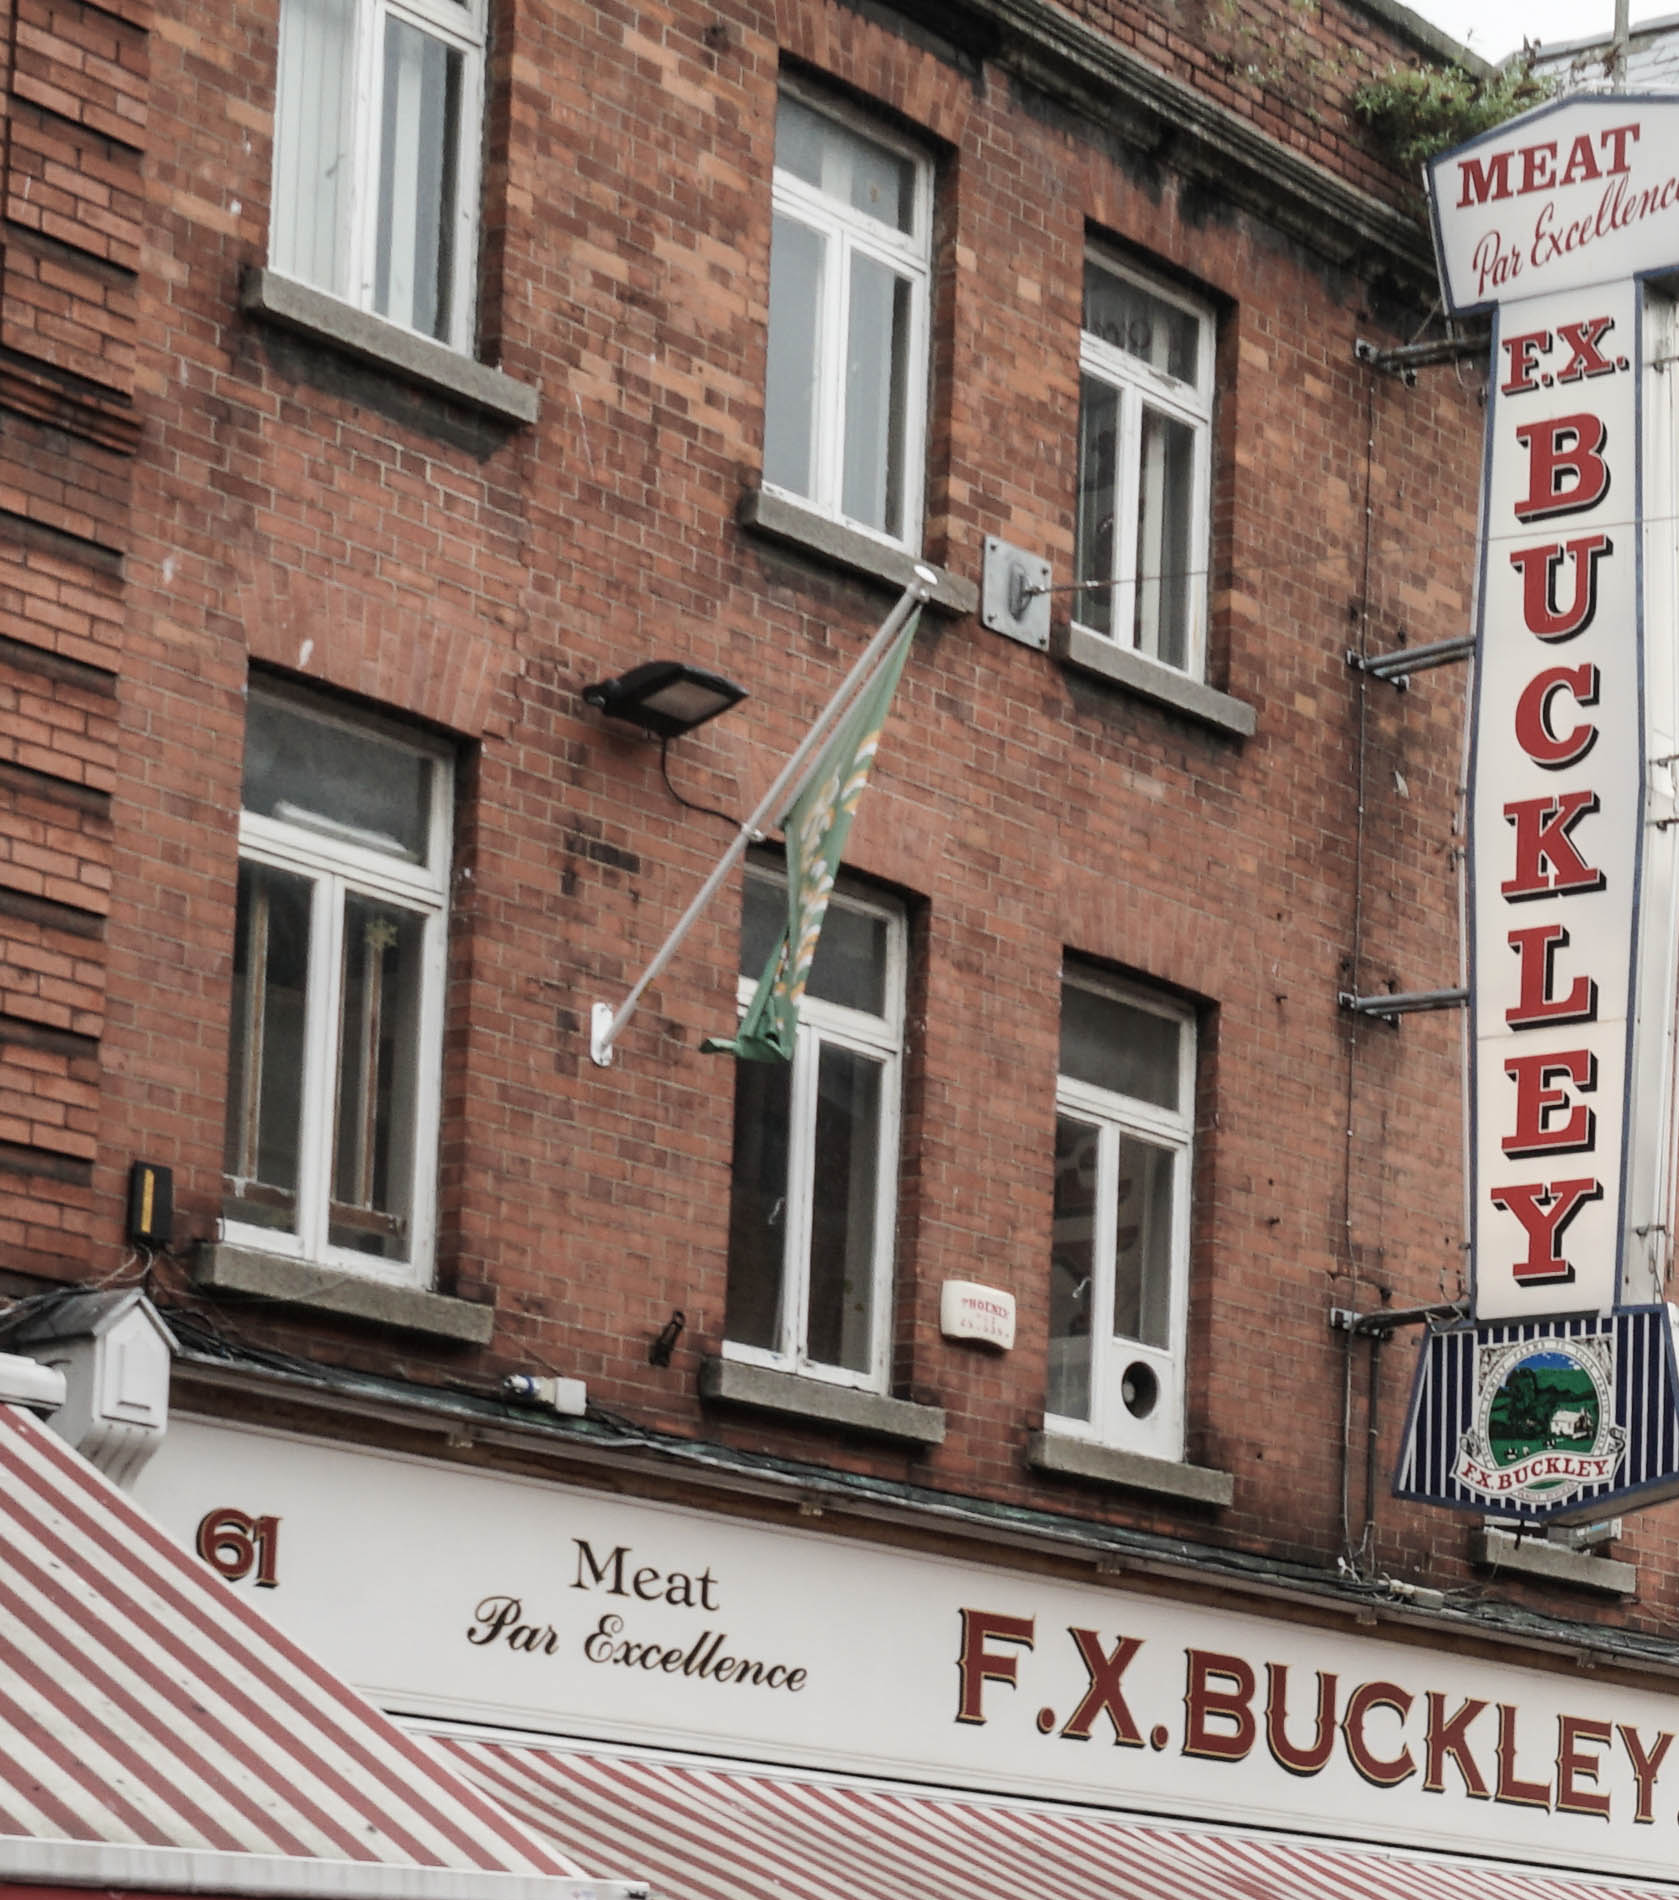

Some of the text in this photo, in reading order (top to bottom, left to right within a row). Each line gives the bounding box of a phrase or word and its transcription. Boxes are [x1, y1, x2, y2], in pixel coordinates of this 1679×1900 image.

[1456, 123, 1641, 209] MEAT
[1472, 229, 1523, 297] Par
[1501, 316, 1630, 395] F.X.
[1490, 412, 1613, 1288] BUCKLEY
[196, 1506, 284, 1588] 61
[571, 1537, 721, 1612] Meat
[466, 1595, 809, 1694] Par Excellence
